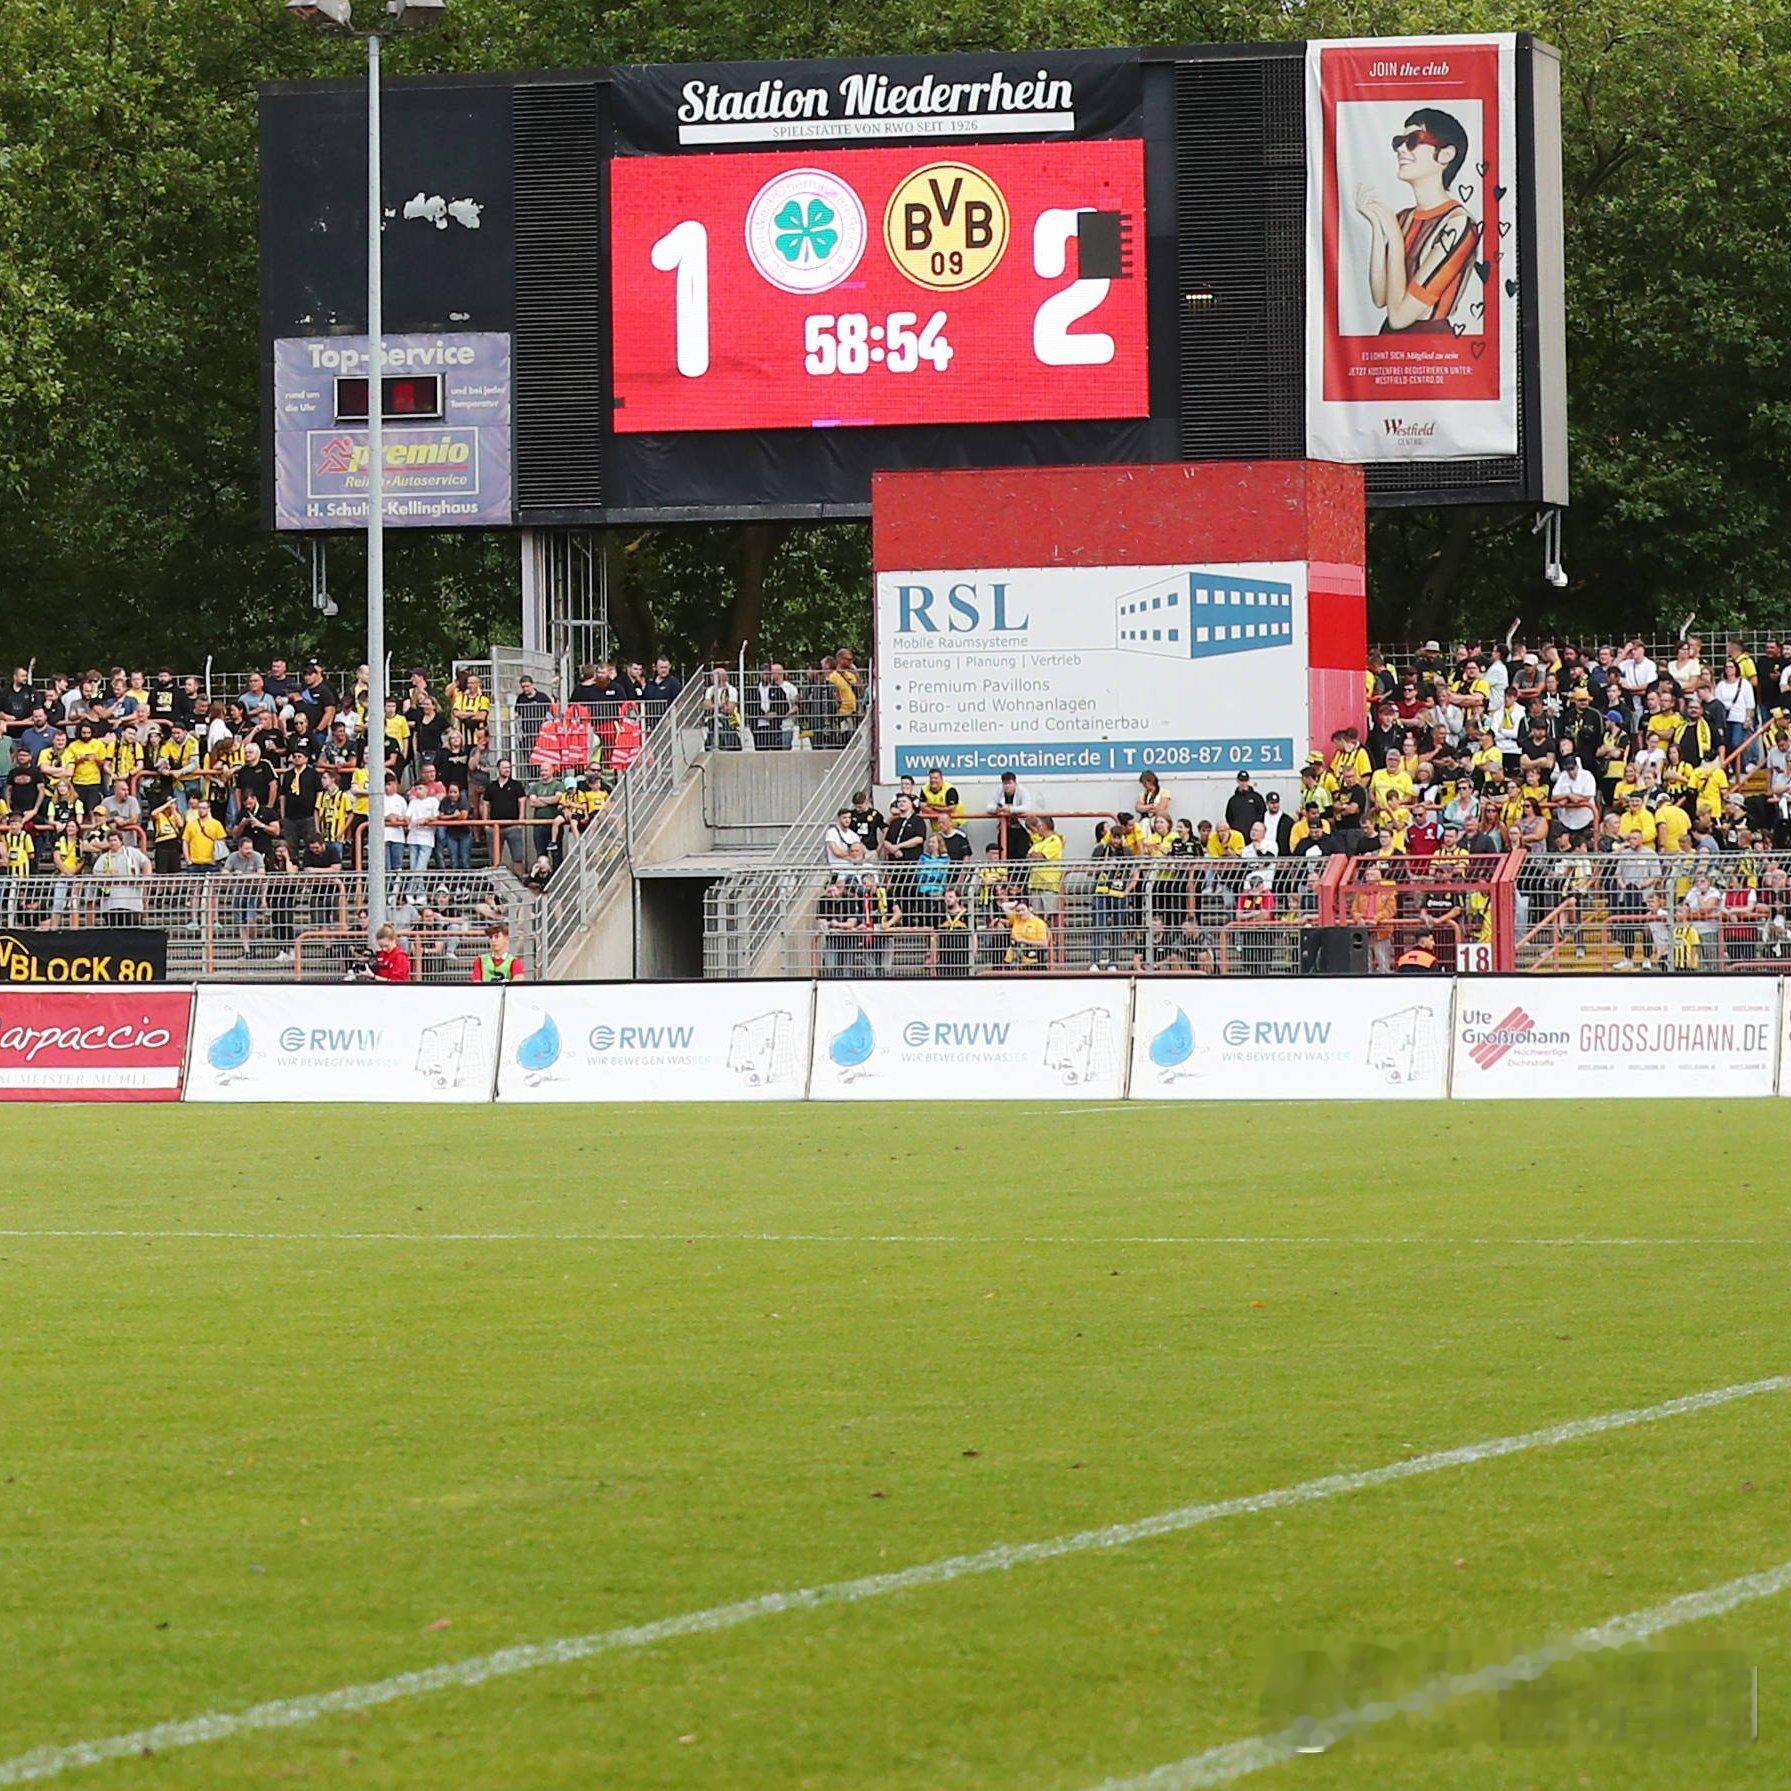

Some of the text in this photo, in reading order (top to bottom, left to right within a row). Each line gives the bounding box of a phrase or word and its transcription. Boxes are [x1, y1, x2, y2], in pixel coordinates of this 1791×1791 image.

[1369, 61, 1450, 77] JOIN the club
[677, 69, 1074, 123] Stadion Niederrhein
[772, 119, 978, 138] SPIELSTÄTTE VON RWO SEIT 1926
[904, 178, 993, 251] BVB
[931, 251, 963, 276] 09
[1032, 206, 1116, 366] 2
[650, 220, 709, 377] 1
[804, 310, 954, 376] 58:54
[1384, 419, 1434, 436] Westfield
[347, 436, 470, 473] pemio
[307, 499, 479, 517] H. Schul-Kellinghaus
[894, 583, 1030, 634] RSL
[893, 636, 1028, 651] Mobile Raumsysteme
[894, 653, 1081, 671] Beratung Planung Vertrieb
[908, 678, 1050, 694] Premium Pavillons
[909, 697, 1097, 715] Büro- und Wohnanlagen
[909, 715, 1149, 733] Raumzellen- und Containerbau
[905, 745, 1283, 769] www.rsl-container.de T 0208-87 02 51
[118, 958, 154, 982] 80
[1459, 946, 1490, 972] 18
[1462, 1009, 1492, 1026] Ute
[619, 1026, 694, 1049] RWW
[934, 1022, 1011, 1046] RWW
[1255, 1021, 1332, 1045] RWW
[1462, 1027, 1570, 1045] Großjohann
[1579, 1023, 1769, 1052] GROSSJOHANN.DE
